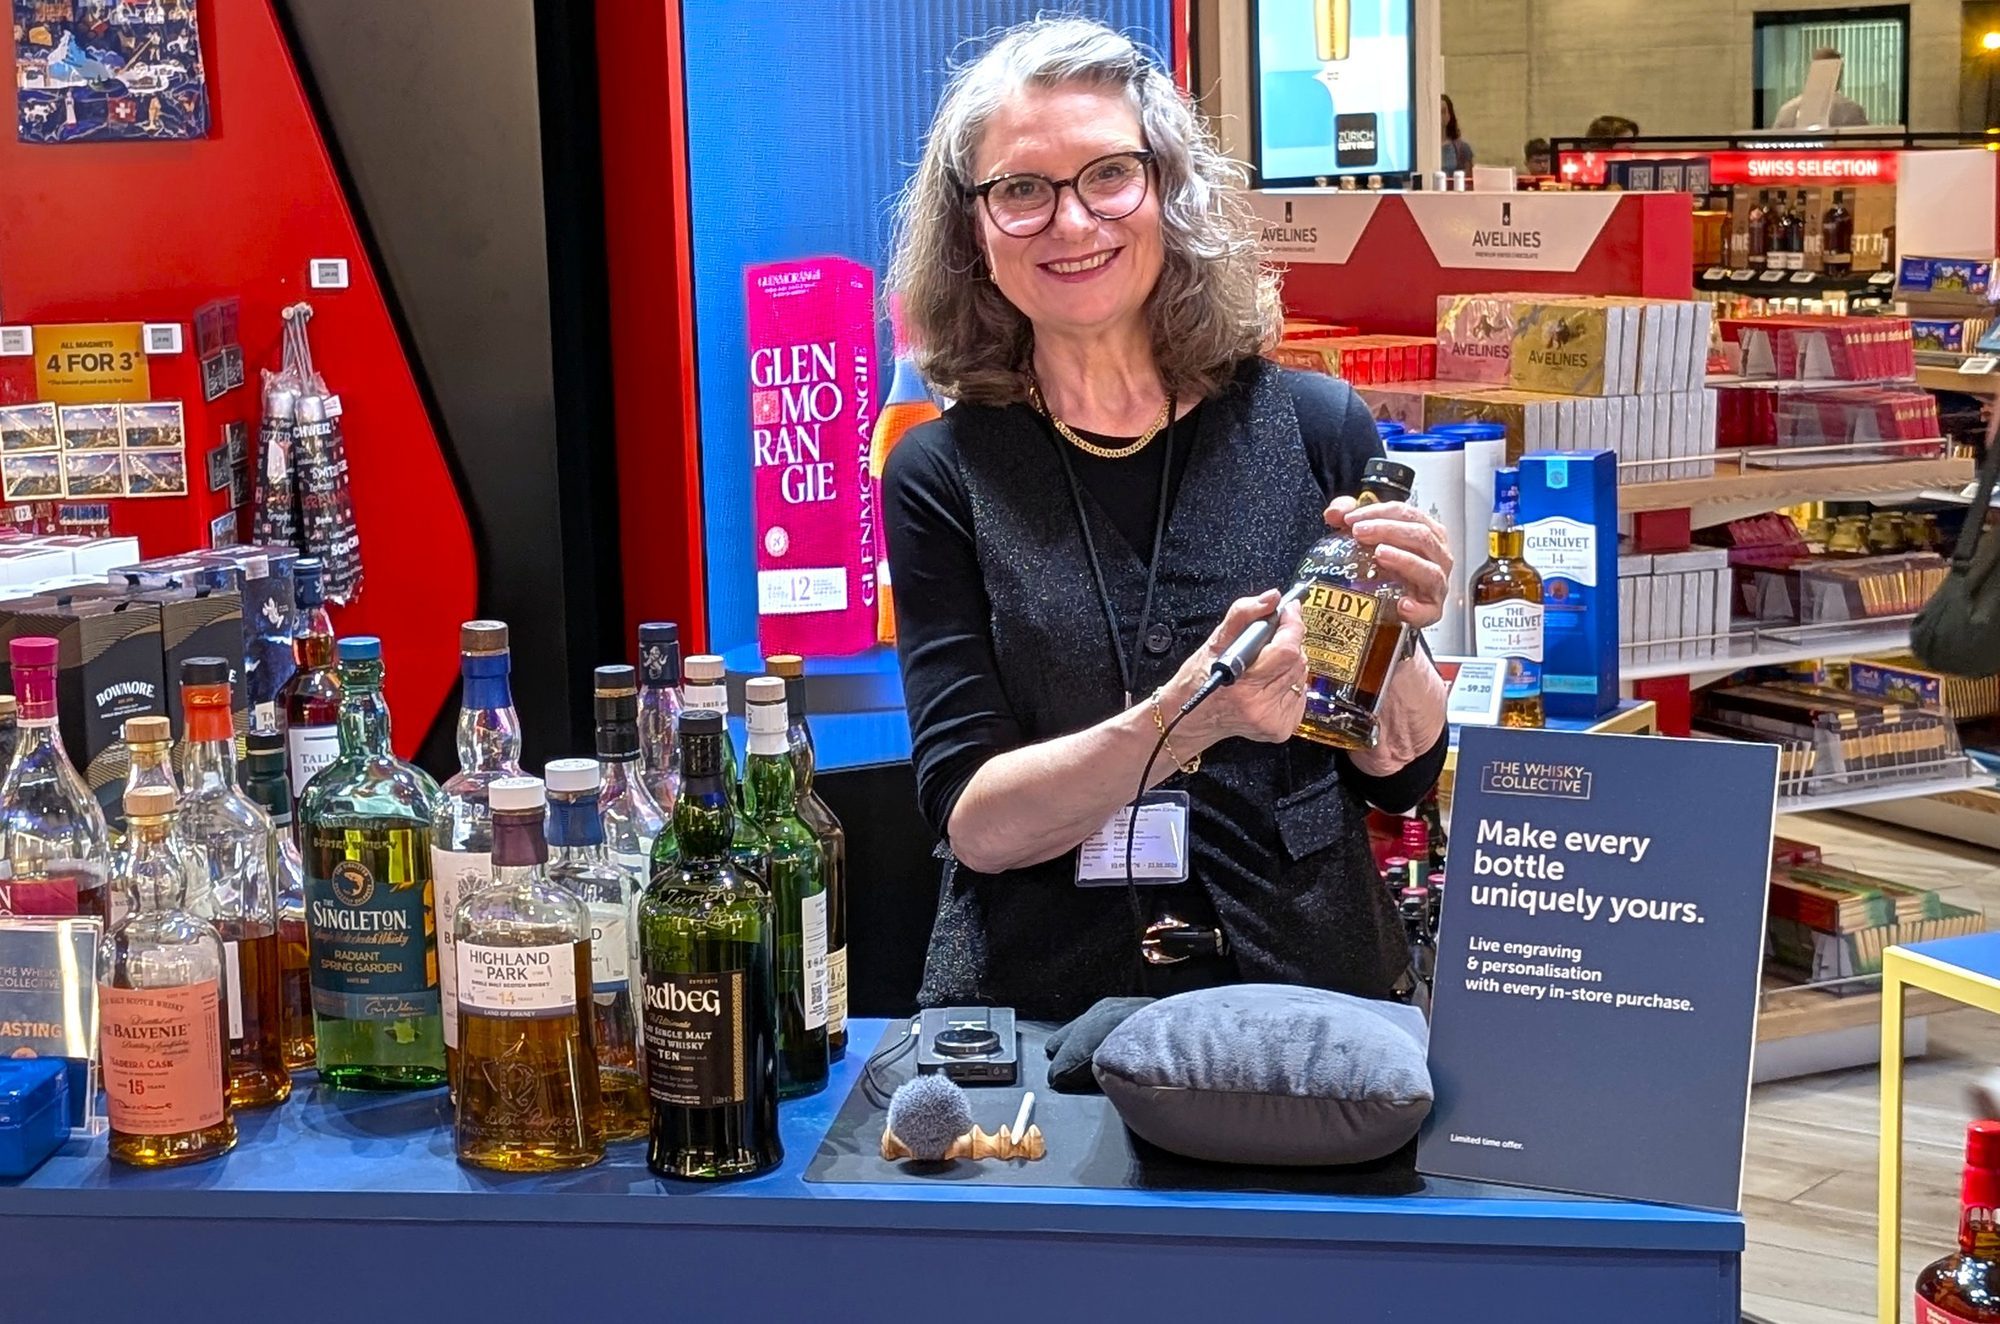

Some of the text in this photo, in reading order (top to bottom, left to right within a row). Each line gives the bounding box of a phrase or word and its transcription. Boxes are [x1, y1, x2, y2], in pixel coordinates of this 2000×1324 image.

[1748, 159, 1878, 177] SWISS SELECTION
[1260, 227, 1318, 243] AVELINES
[1472, 230, 1541, 248] AVELINES
[61, 340, 114, 349] ALL MAGNETS
[1451, 341, 1510, 359] AVELINES
[47, 354, 61, 373] 4
[68, 353, 114, 372] FOR
[751, 342, 836, 388] GLEN
[1528, 350, 1588, 368] AVELINES
[781, 382, 843, 424] MO
[753, 423, 821, 467] RAN
[781, 462, 837, 504] GIE
[1550, 528, 1567, 536] THE
[1526, 537, 1590, 550] GLENLIVET
[1552, 553, 1565, 564] 14
[791, 576, 811, 601] 12
[1506, 608, 1524, 616] THE
[1482, 614, 1541, 629] GLENLIVET
[1508, 634, 1521, 645] 14
[96, 681, 156, 707] BOWMORE
[1491, 761, 1585, 779] THE WHISKY
[1491, 775, 1582, 793] COLLECTIVE
[1476, 819, 1651, 862] Make every
[1473, 849, 1565, 881] bottle
[323, 899, 334, 907] THE
[1471, 882, 1705, 924] uniquely yours.
[313, 900, 408, 931] SINGLETON
[334, 950, 380, 961] RADIANT
[469, 949, 550, 966] HIGHLAND
[1469, 936, 1582, 963] Live engraving
[320, 959, 403, 973] SPRING GARDEN
[486, 966, 528, 981] PARK
[1467, 956, 1602, 982] & personalisation
[1465, 977, 1695, 1012] with every in-store purchase.
[113, 1023, 188, 1039] BALVENIE
[685, 1031, 713, 1040] MALT
[667, 1039, 705, 1051] WHISKY
[657, 1048, 680, 1061] TEN
[147, 1059, 174, 1069] CASK
[128, 1078, 145, 1095] 15
[1450, 1133, 1524, 1150] Limited time offer.
